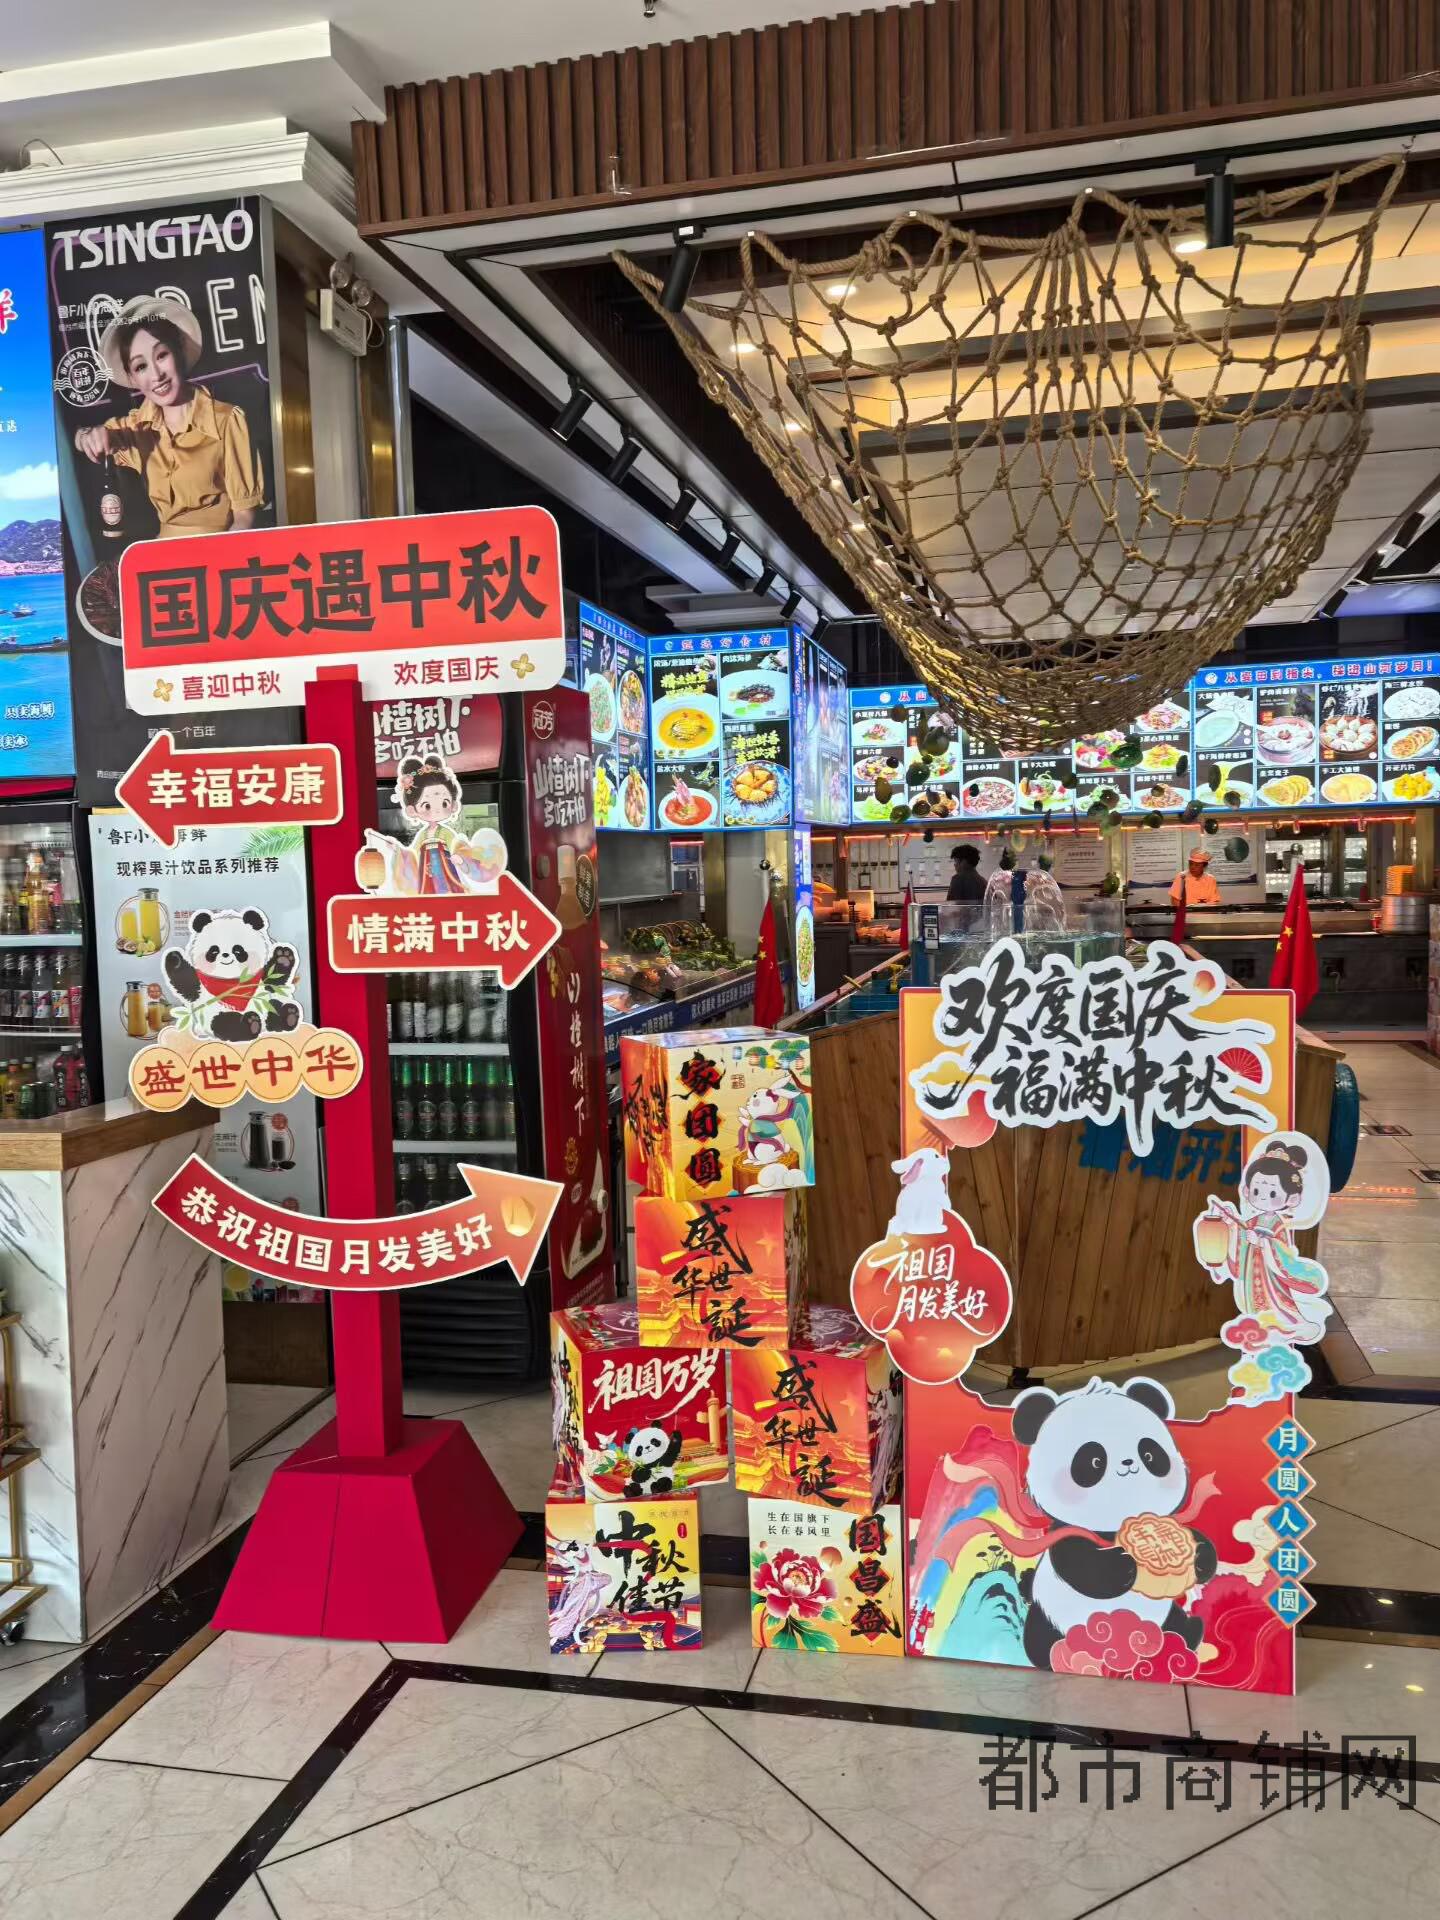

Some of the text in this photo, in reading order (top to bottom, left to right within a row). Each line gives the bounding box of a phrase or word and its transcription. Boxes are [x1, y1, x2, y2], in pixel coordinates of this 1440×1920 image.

[53, 209, 254, 271] TSINGTAO
[137, 536, 547, 648] 国庆遇中秋
[182, 670, 281, 700] 喜迎中秋
[394, 656, 499, 686] 欢度国庆
[148, 725, 216, 739] 一个百年
[147, 763, 325, 809] 幸福安康
[532, 753, 591, 799] 山楂树下
[544, 795, 586, 828] 多吃不怕
[107, 828, 208, 845] 鲁F小鲜
[116, 857, 280, 877] 现榨果汁饮品系列推荐
[347, 910, 531, 954] 情满中秋
[138, 1044, 357, 1097] 盛世中华
[991, 1046, 1268, 1146] 福满中秋
[181, 1185, 493, 1275] 恭祝祖国月发美好
[867, 1243, 955, 1284] 祖国
[872, 1284, 995, 1336] 月发美好
[588, 1349, 720, 1420] 祖国万岁
[767, 1511, 831, 1525] 生在国旗下
[1276, 1426, 1300, 1614] 月圆人团圆
